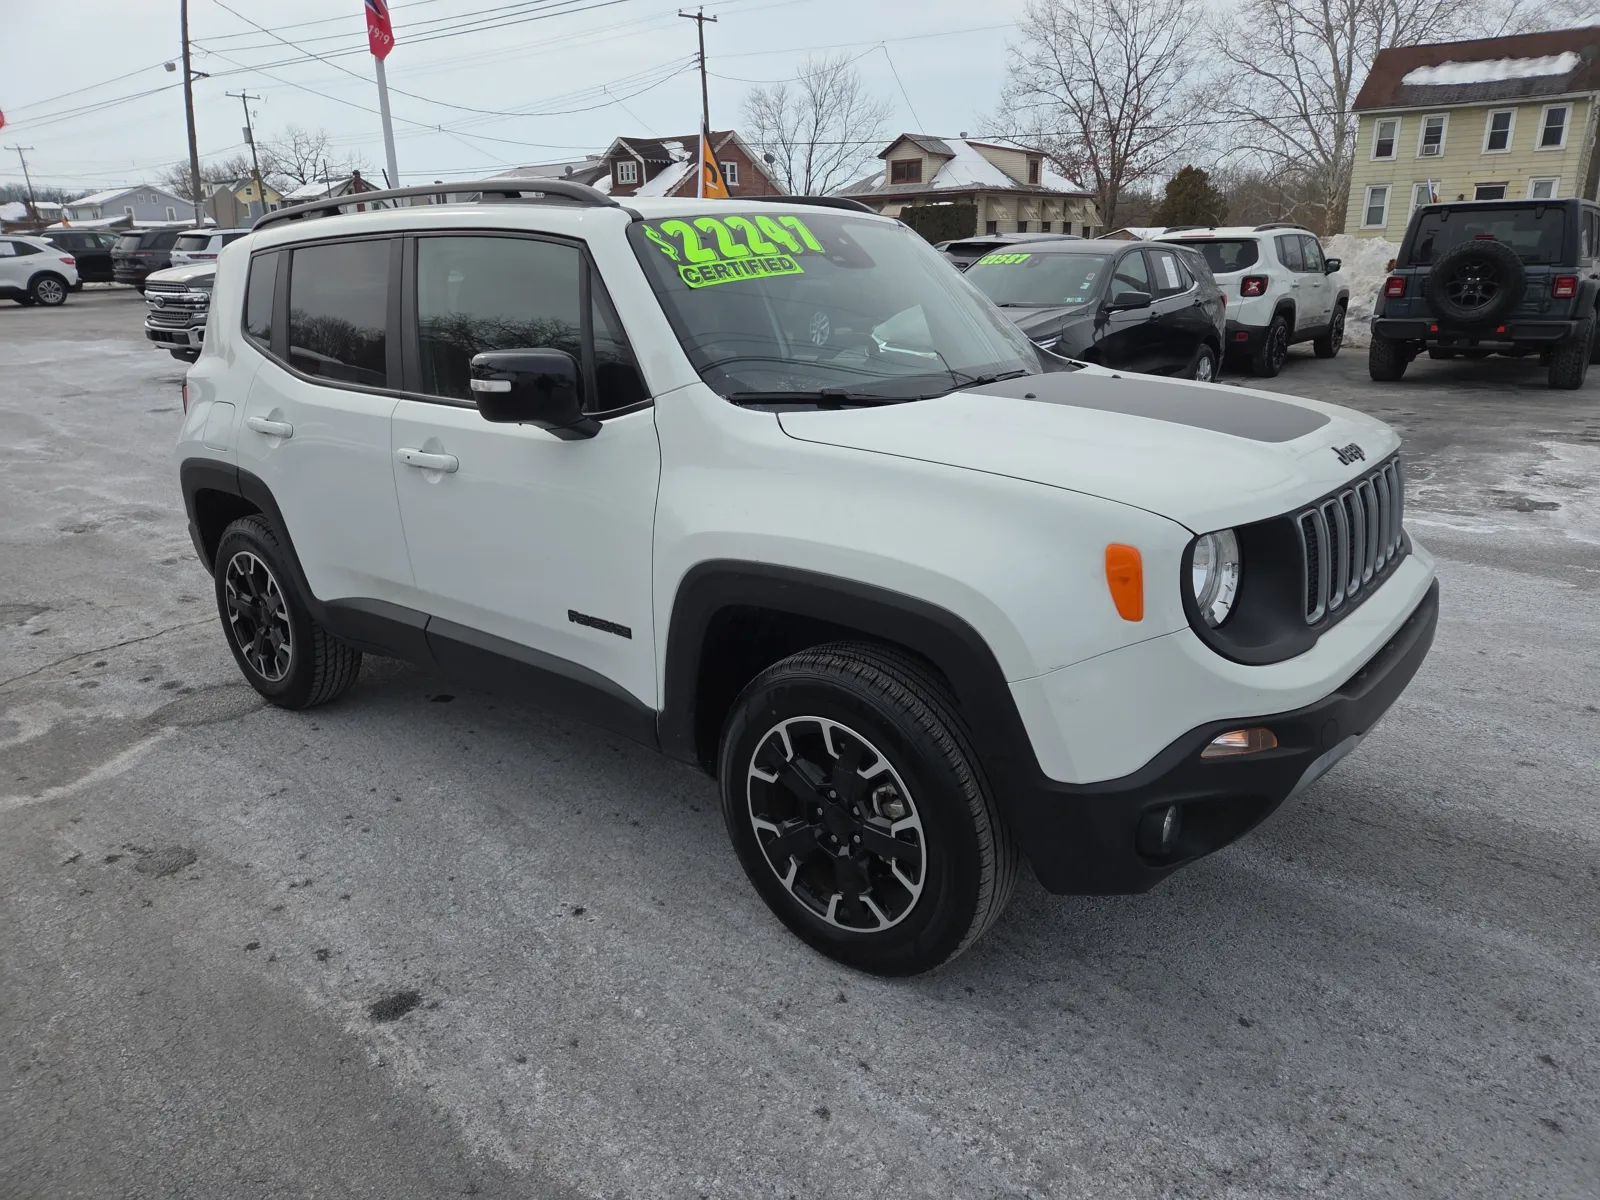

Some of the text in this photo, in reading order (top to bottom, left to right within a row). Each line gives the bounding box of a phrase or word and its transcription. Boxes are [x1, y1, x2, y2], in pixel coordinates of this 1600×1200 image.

[368, 24, 390, 45] 1979
[642, 215, 825, 263] $22247
[682, 256, 797, 285] CERTIFIED
[1331, 442, 1366, 466] Jeep
